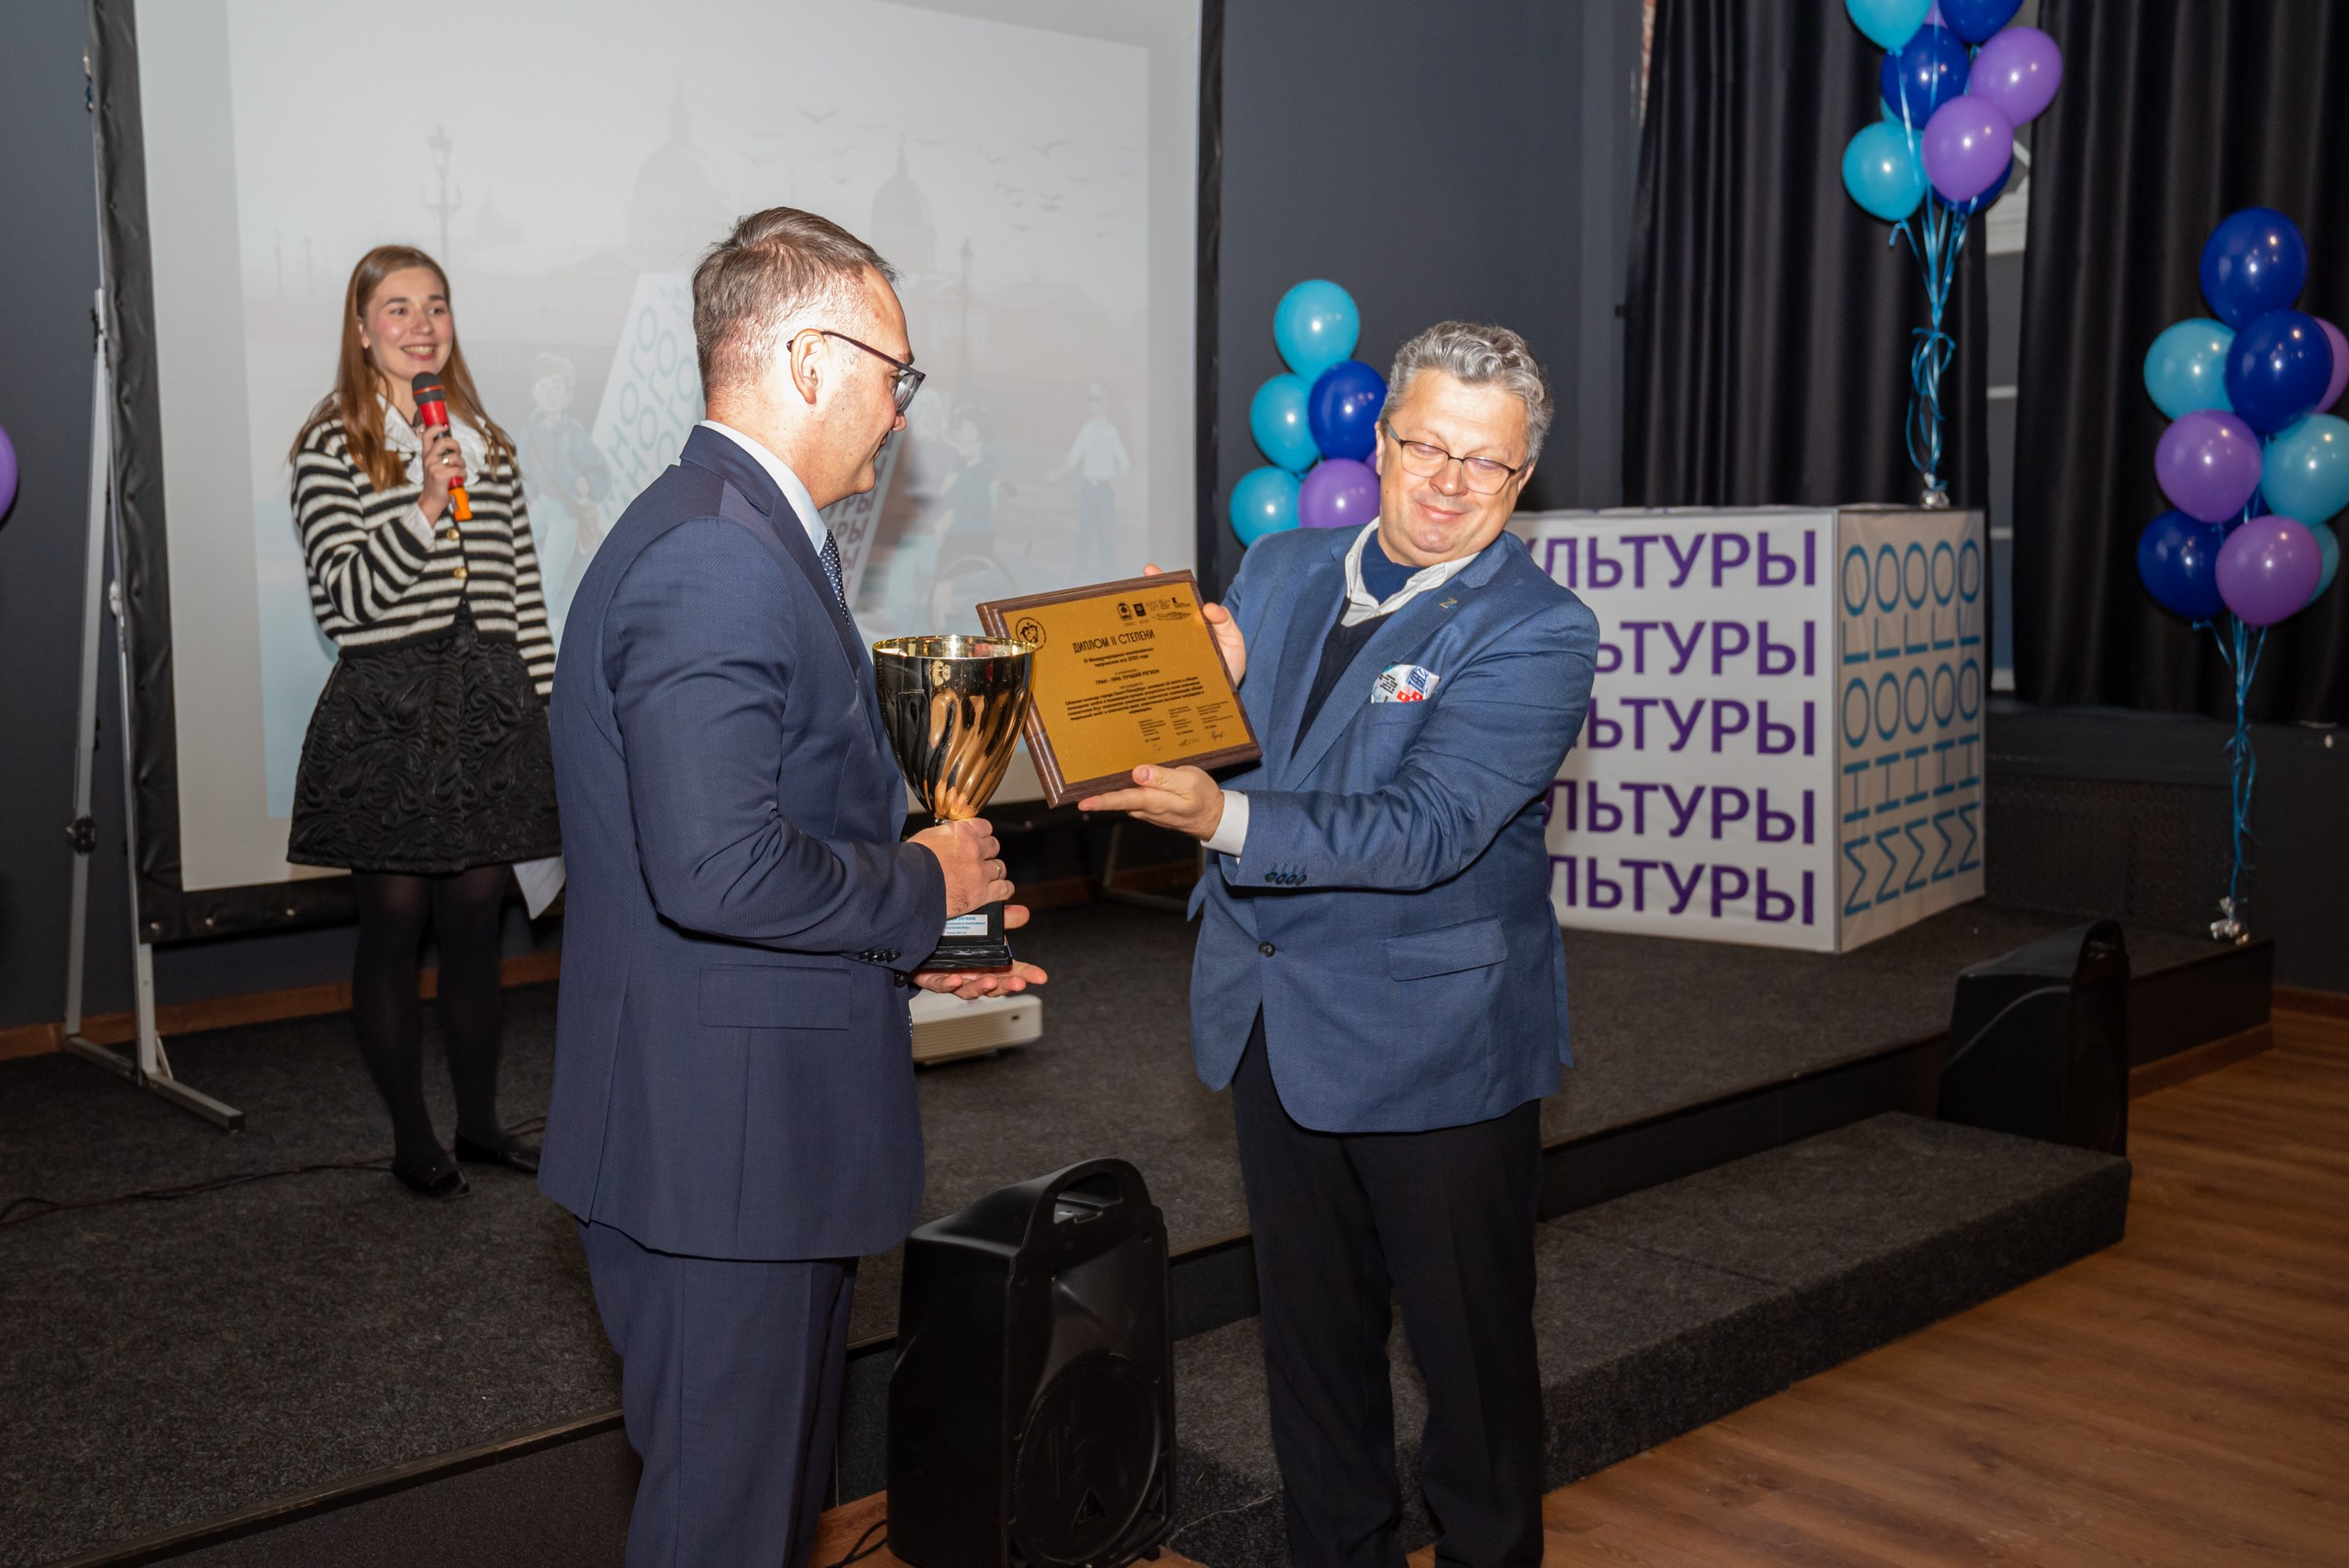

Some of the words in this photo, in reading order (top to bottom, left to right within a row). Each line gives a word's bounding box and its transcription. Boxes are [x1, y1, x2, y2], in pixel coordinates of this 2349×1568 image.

[621, 328, 677, 507] НОГО
[1526, 529, 1816, 589] ЛЬТУРЫ
[1072, 637, 1110, 653] ДИПЛОМ
[1109, 636, 1118, 646] II
[1118, 629, 1155, 644] СТЕПЕНИ
[1571, 696, 1816, 756] ЬТУРЫ
